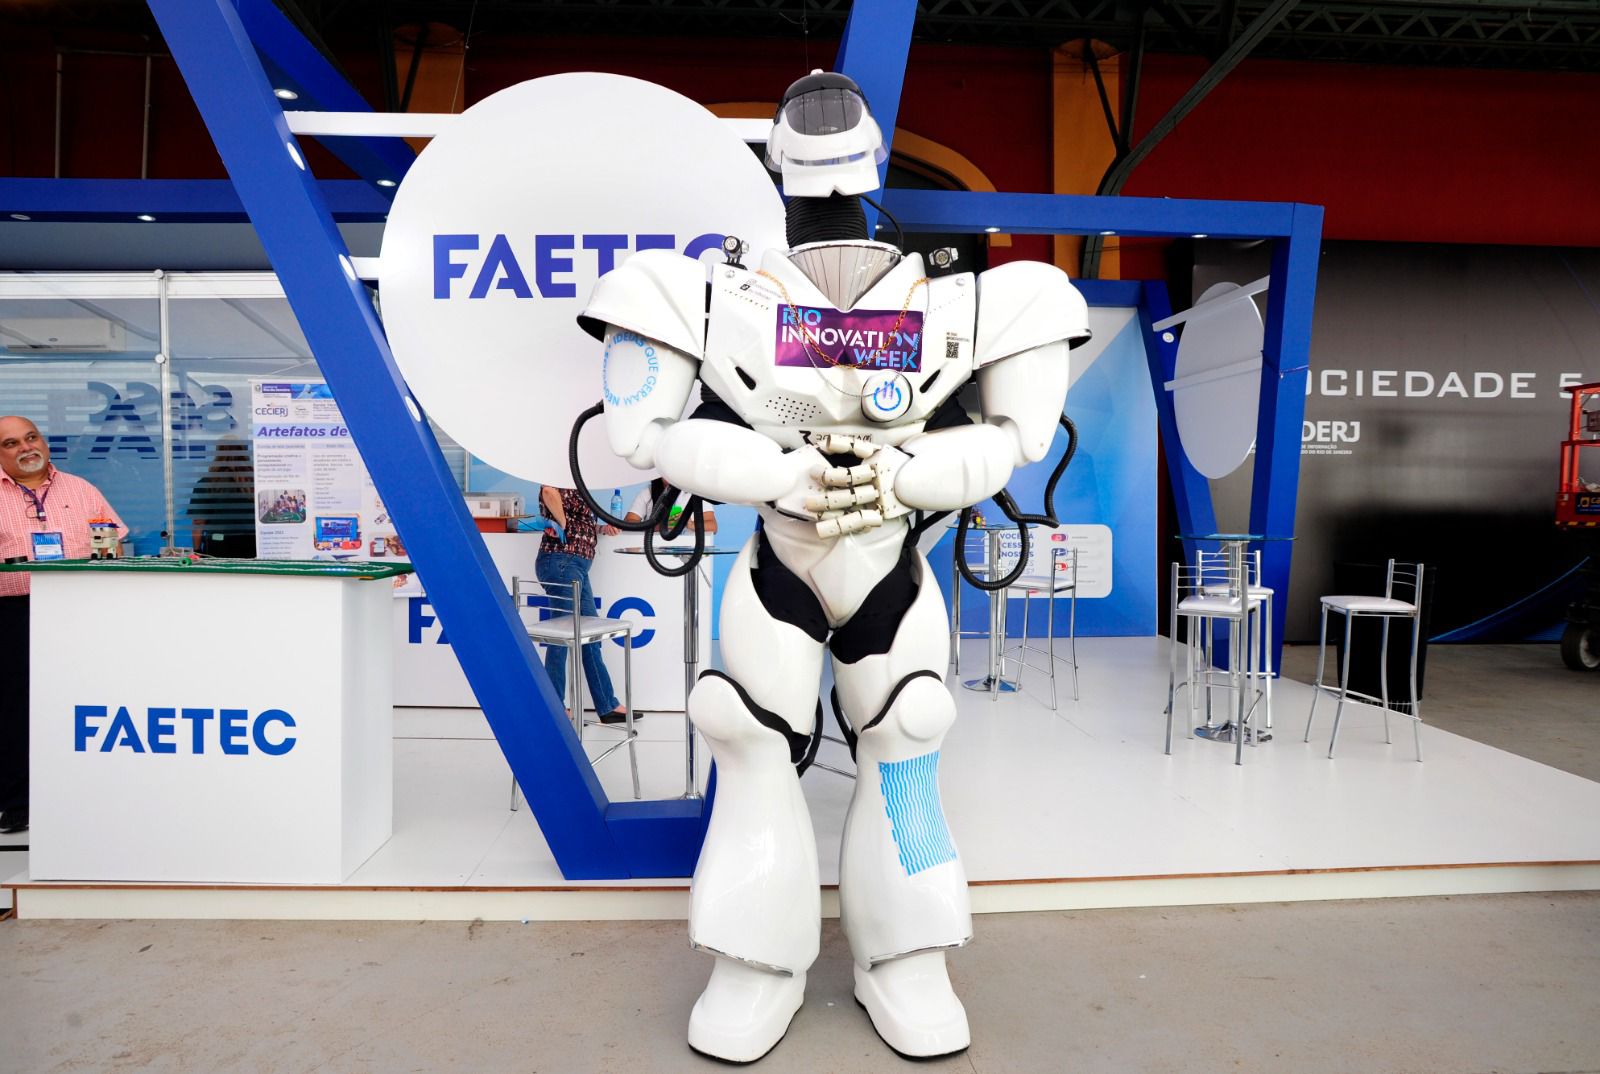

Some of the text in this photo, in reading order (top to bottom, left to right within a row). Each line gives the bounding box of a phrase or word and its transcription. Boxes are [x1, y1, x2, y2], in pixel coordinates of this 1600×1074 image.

[433, 233, 725, 299] FAET
[782, 307, 822, 326] RIO
[645, 346, 659, 373] QUE
[853, 348, 918, 369] WEEK
[1305, 369, 1536, 398] CIEDADE
[255, 407, 289, 418] CECIERJ
[257, 425, 349, 438] Artefatos de
[74, 705, 297, 756] FAETEC
